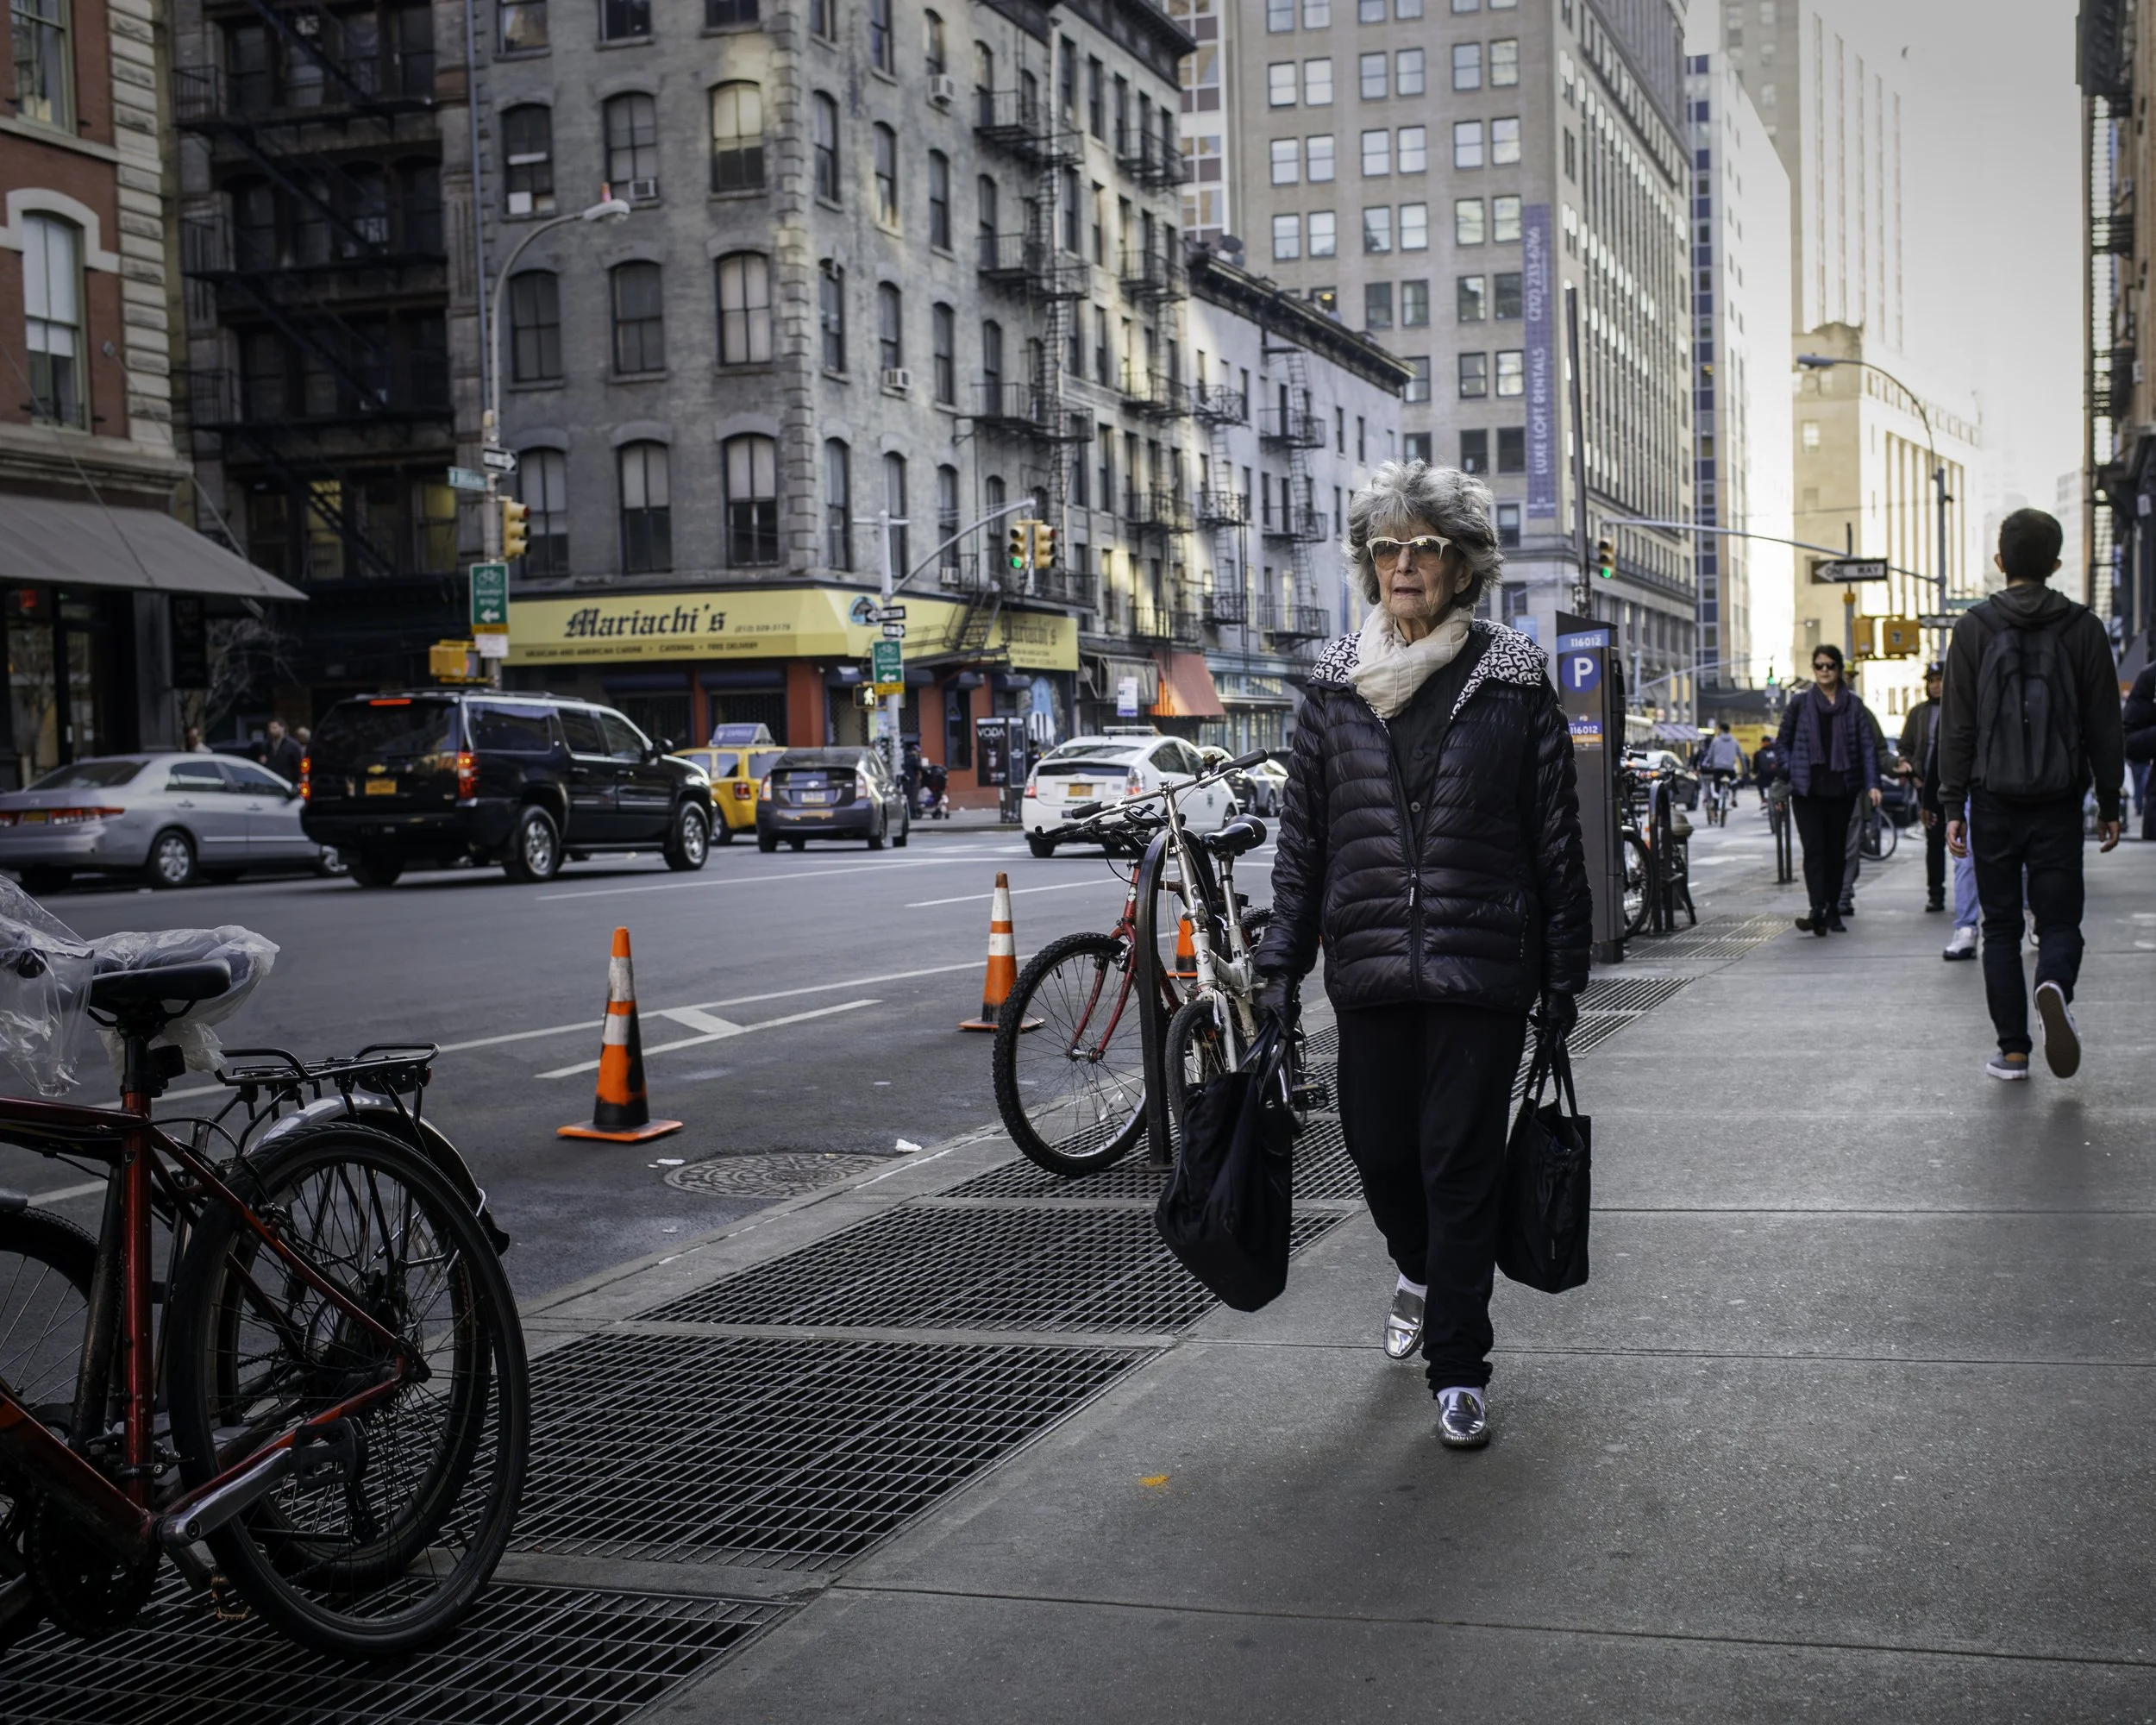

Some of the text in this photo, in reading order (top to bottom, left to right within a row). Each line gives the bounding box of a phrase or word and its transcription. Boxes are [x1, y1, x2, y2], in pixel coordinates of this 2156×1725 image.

[1531, 347, 1546, 404] RENTALS
[1532, 407, 1547, 440] LOFT
[1534, 442, 1549, 474] LUXE
[1824, 565, 1880, 577] ONE WAY
[563, 603, 728, 638] Mariachi's
[1570, 637, 1601, 647] 116012
[1574, 657, 1594, 688] P
[1570, 725, 1599, 735] 116012
